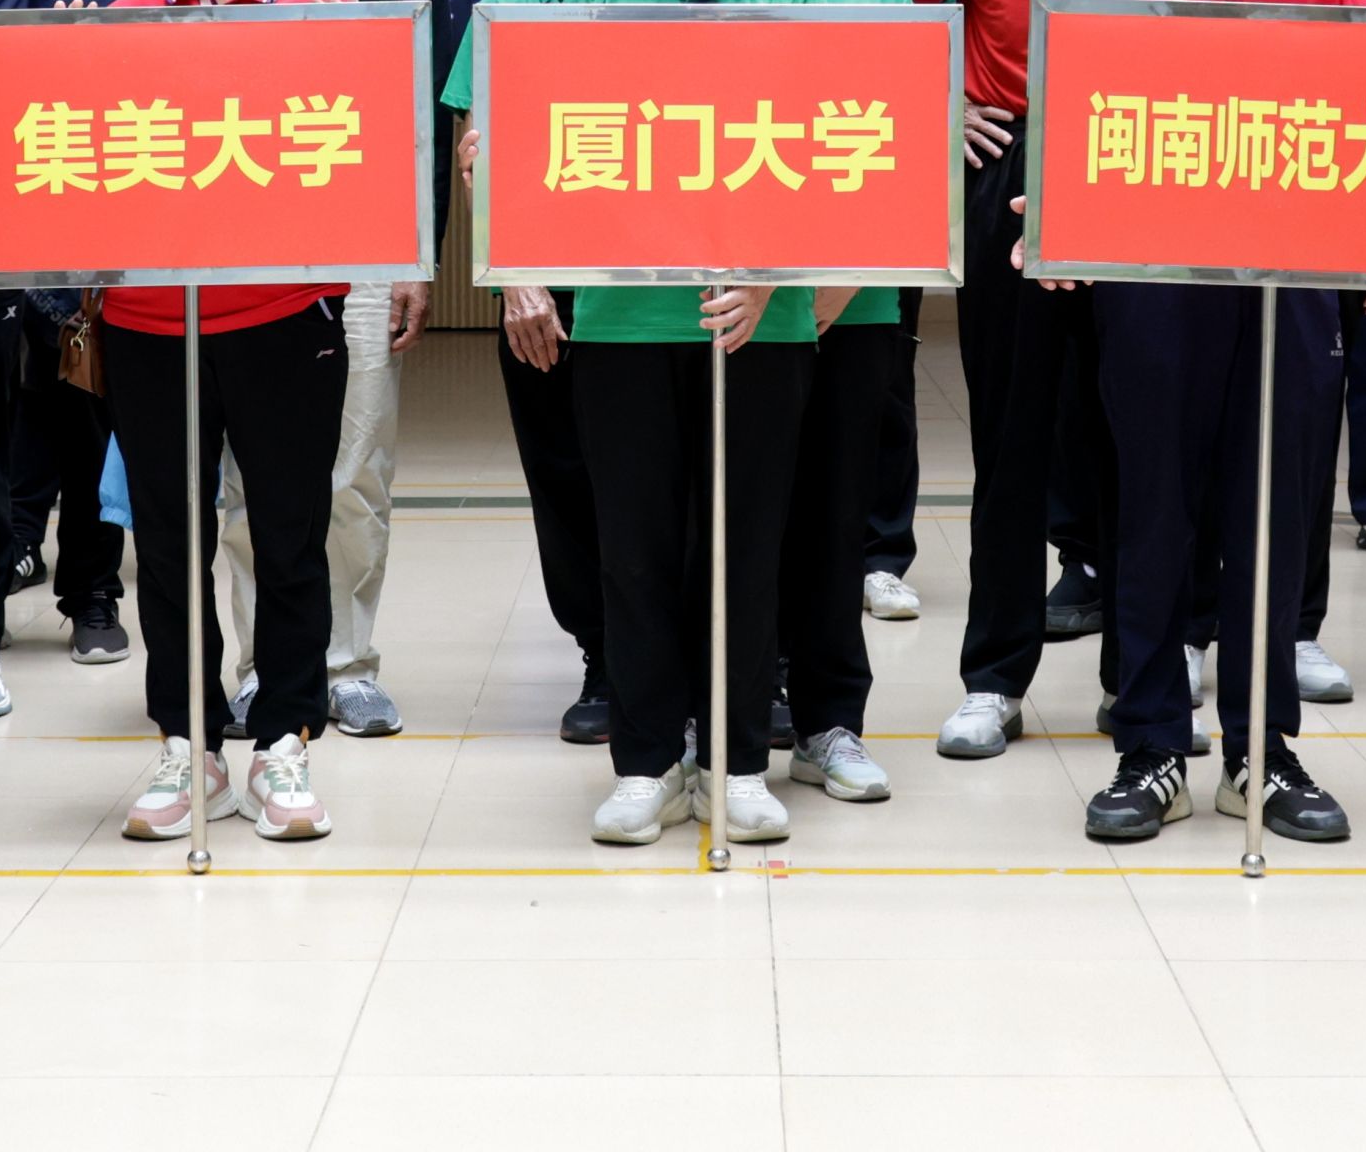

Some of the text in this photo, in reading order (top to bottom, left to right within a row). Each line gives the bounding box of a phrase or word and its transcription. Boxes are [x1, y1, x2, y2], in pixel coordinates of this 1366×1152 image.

[14, 95, 363, 194] 集美大学
[544, 100, 895, 192] 厦门大学
